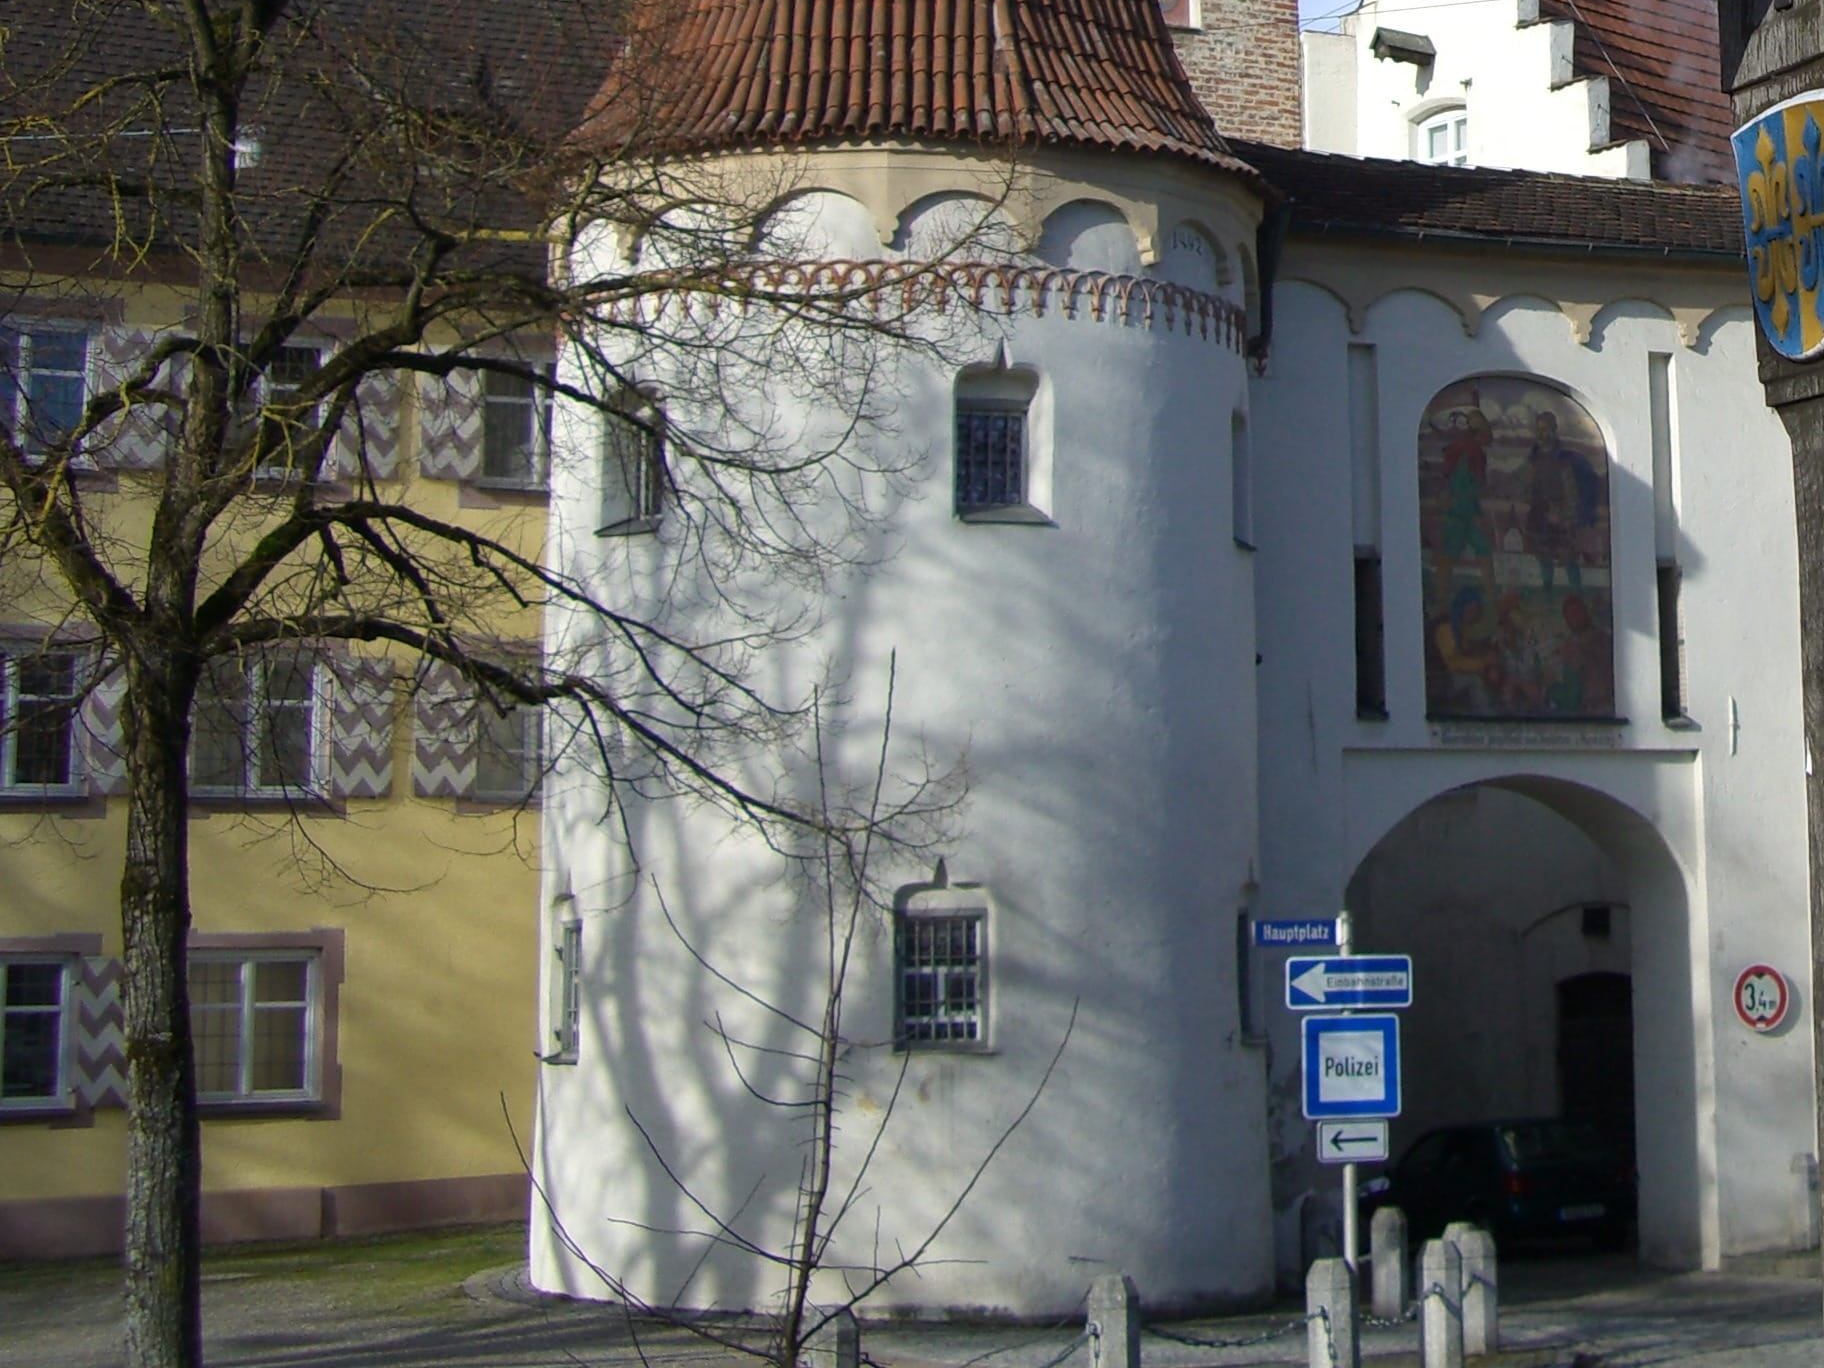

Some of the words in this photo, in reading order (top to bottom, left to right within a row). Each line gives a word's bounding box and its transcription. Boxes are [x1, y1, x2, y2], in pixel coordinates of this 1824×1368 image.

[1263, 924, 1330, 942] Hauptplatz
[1326, 976, 1404, 988] Einbahnstraße
[1325, 1056, 1379, 1078] Polizei
